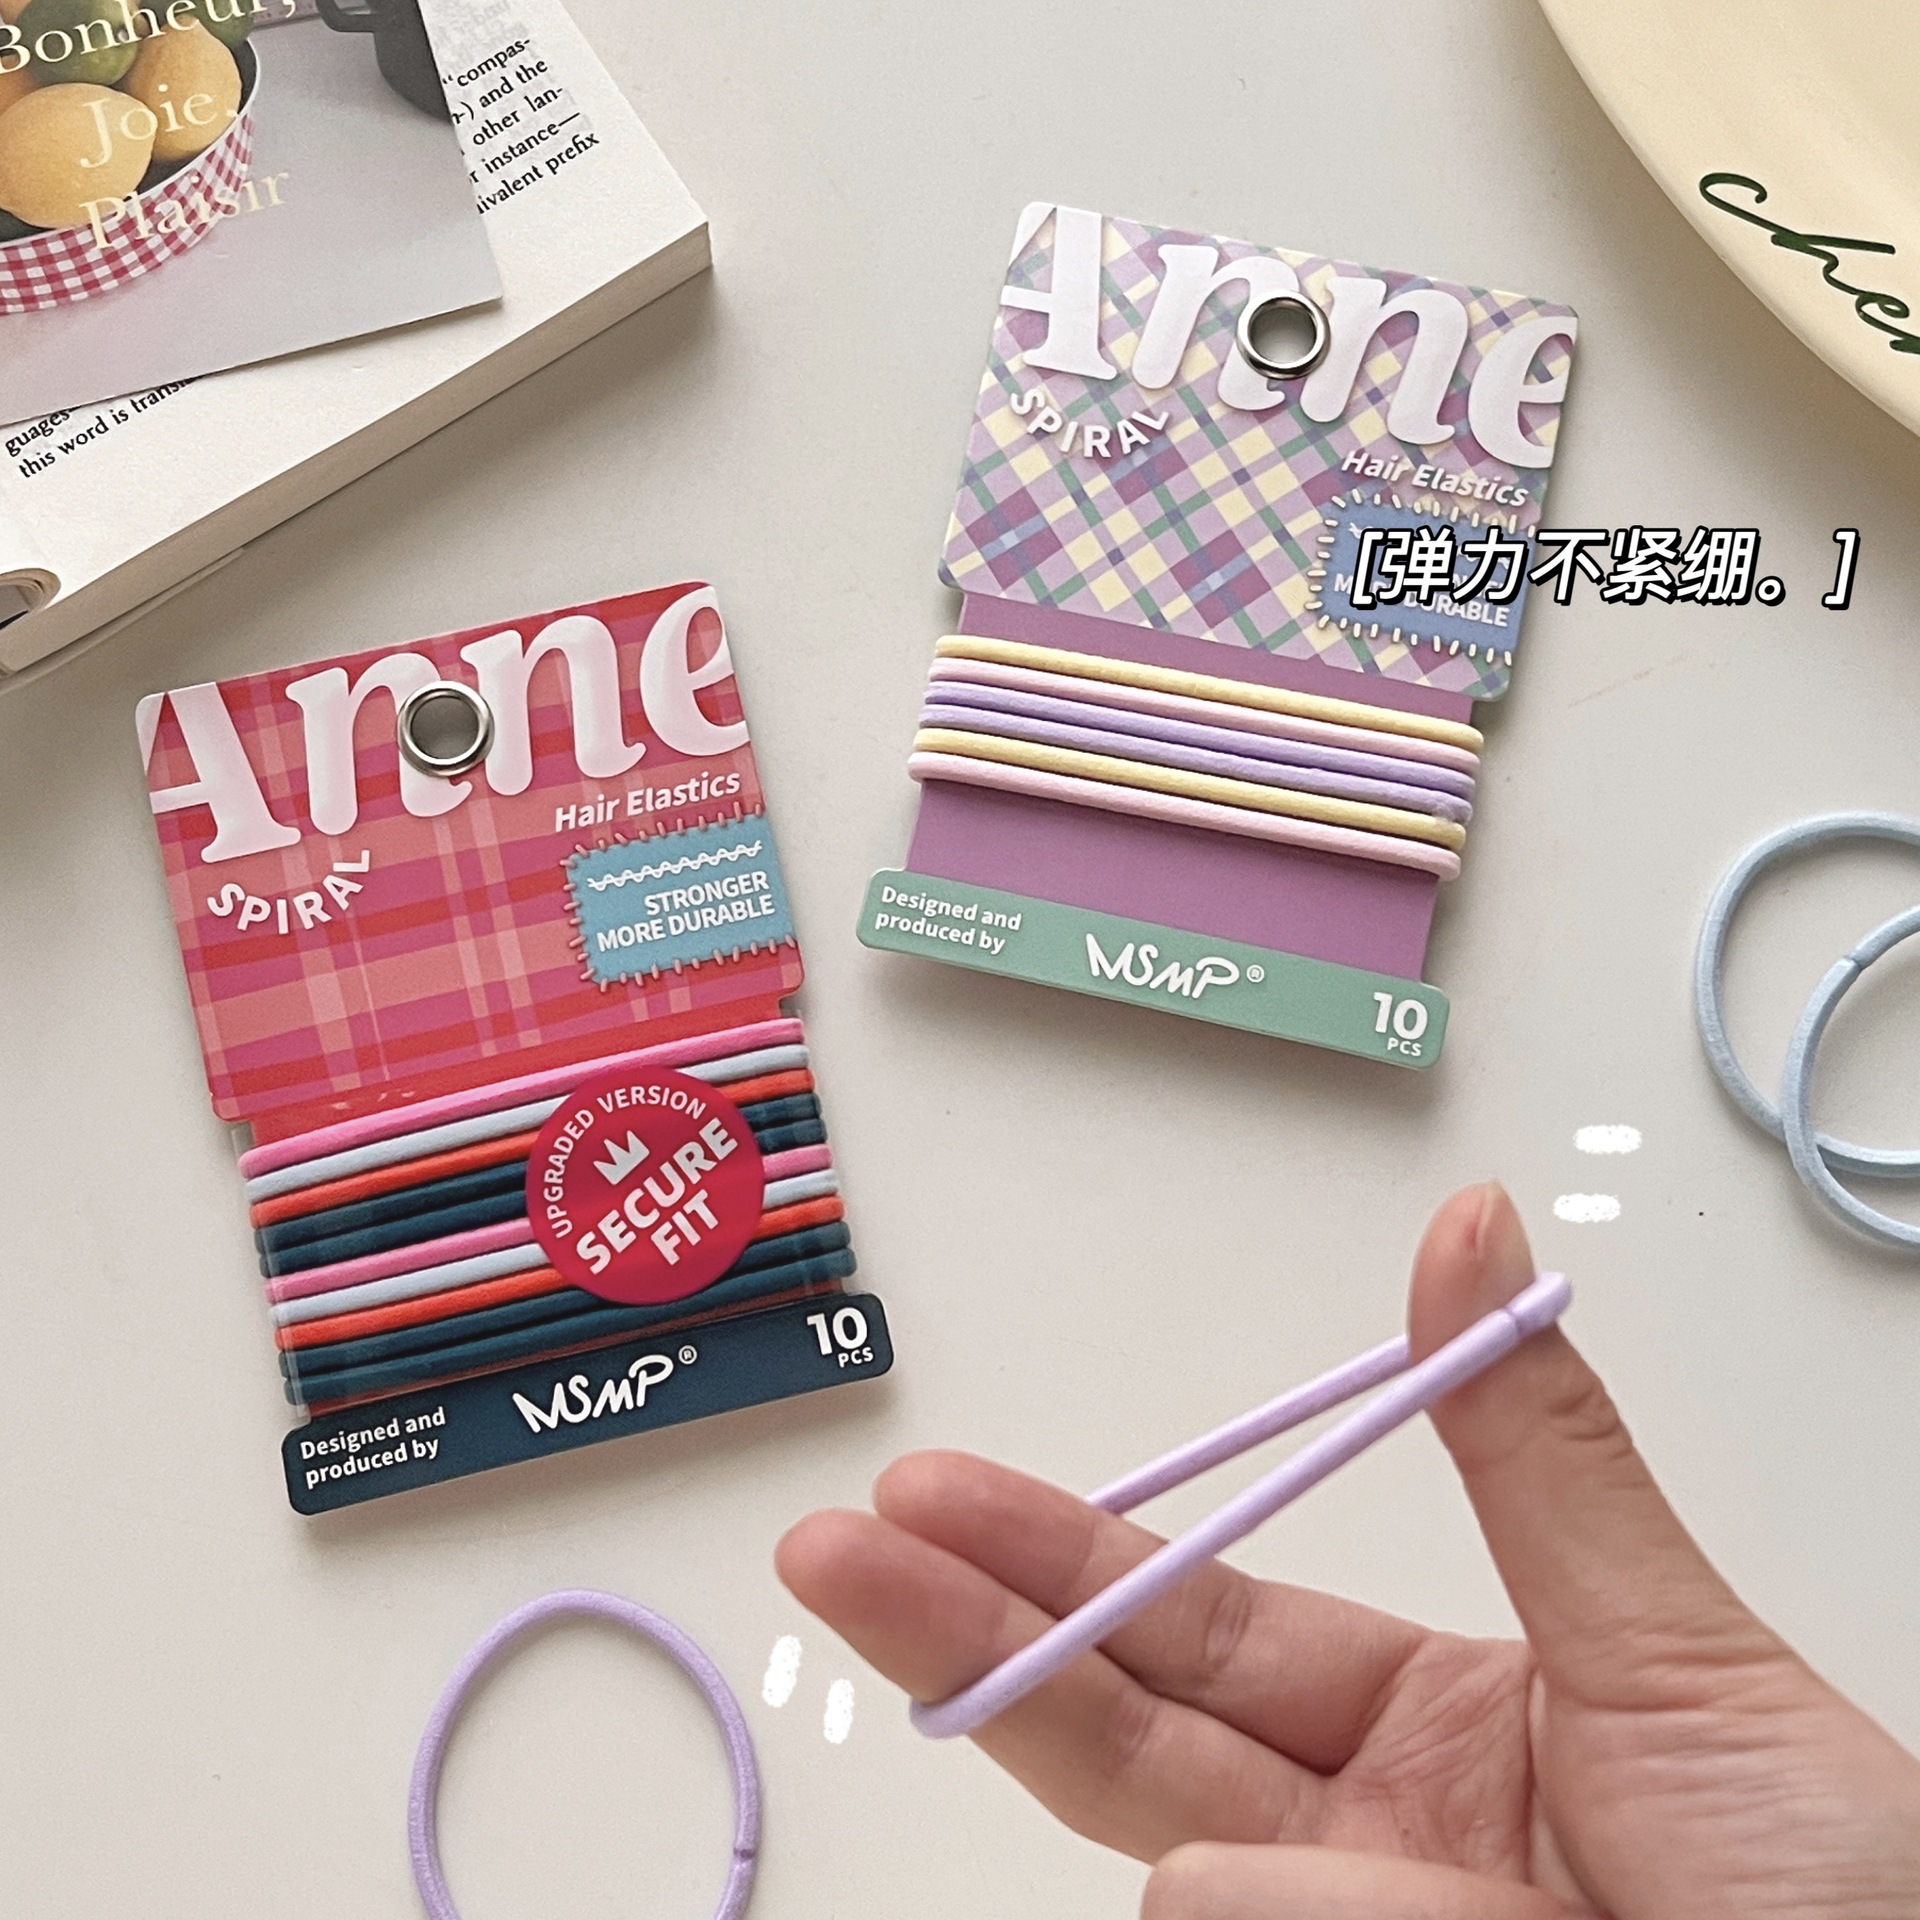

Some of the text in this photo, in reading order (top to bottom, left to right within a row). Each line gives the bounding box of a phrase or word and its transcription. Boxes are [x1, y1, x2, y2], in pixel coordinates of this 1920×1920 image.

[479, 76, 514, 108] and
[515, 60, 548, 84] the
[472, 88, 563, 146] other lan-
[545, 133, 600, 176] prefix
[79, 163, 290, 251] Plaisir
[1001, 203, 1578, 468] Anne
[19, 451, 56, 478] this
[57, 415, 110, 455] word
[109, 408, 129, 425] is
[1010, 390, 1170, 458] SPIRAL
[1341, 449, 1530, 507] Hair Elastics
[136, 587, 750, 862] Anne
[555, 771, 740, 832] Hair Elastics
[207, 849, 370, 935] SPIRAL
[643, 870, 769, 916] STRONGER
[881, 885, 1022, 931] Designed and
[596, 894, 775, 952] MORE DURABLE
[874, 912, 1006, 955] produced by
[1373, 992, 1428, 1041] 10
[1387, 1037, 1422, 1057] PCS
[543, 1085, 707, 1239] UPGRADED VERSION
[576, 1117, 739, 1275] SECURE
[650, 1188, 719, 1266] FIT
[806, 1306, 869, 1356] 10
[838, 1346, 875, 1369] PCS
[300, 1405, 446, 1460] Designed and
[305, 1438, 439, 1490] produced by
